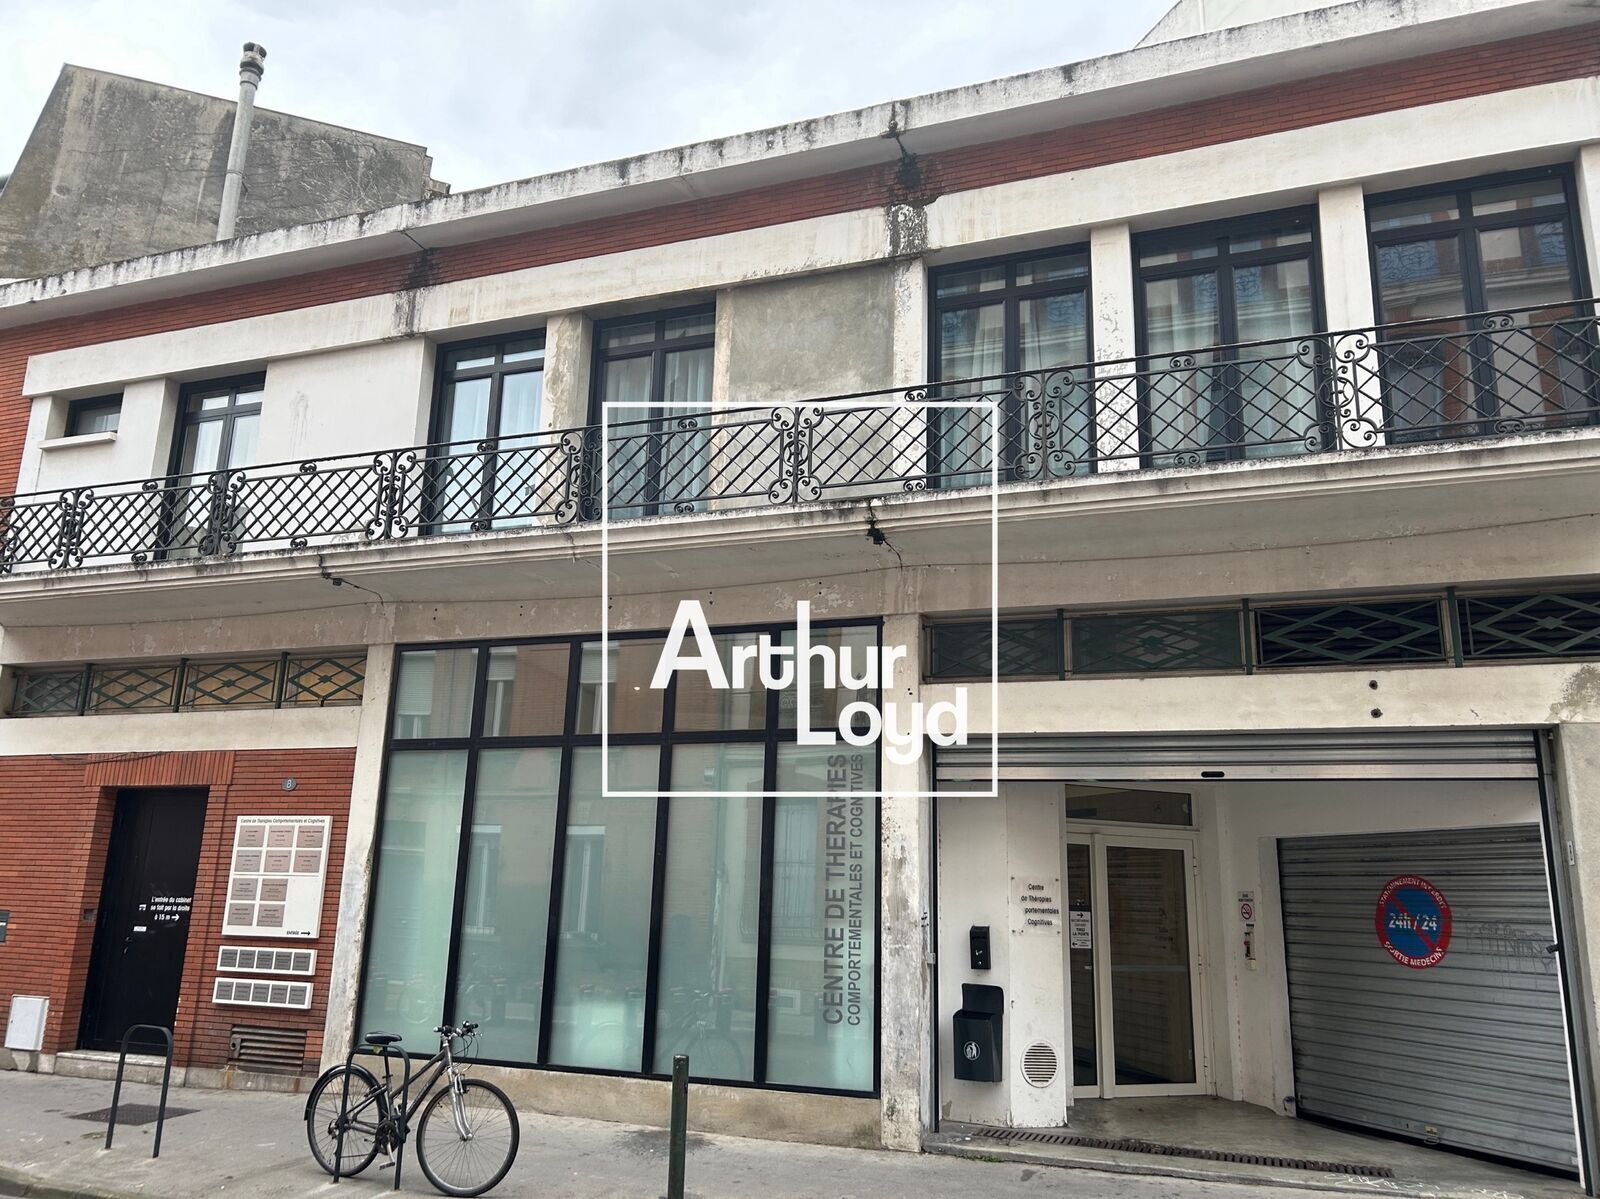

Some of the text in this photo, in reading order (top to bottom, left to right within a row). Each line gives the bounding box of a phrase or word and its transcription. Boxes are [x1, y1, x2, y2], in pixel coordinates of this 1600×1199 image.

[823, 754, 848, 1025] CENTRE DE THERAPIES
[847, 754, 864, 1026] COMPORTEMENTALES ET COGNTIVES
[1028, 883, 1044, 891] Centre
[164, 904, 172, 912] par
[177, 904, 190, 912] droite
[1027, 918, 1053, 927] Cognitives
[1384, 941, 1409, 964] SORTIE
